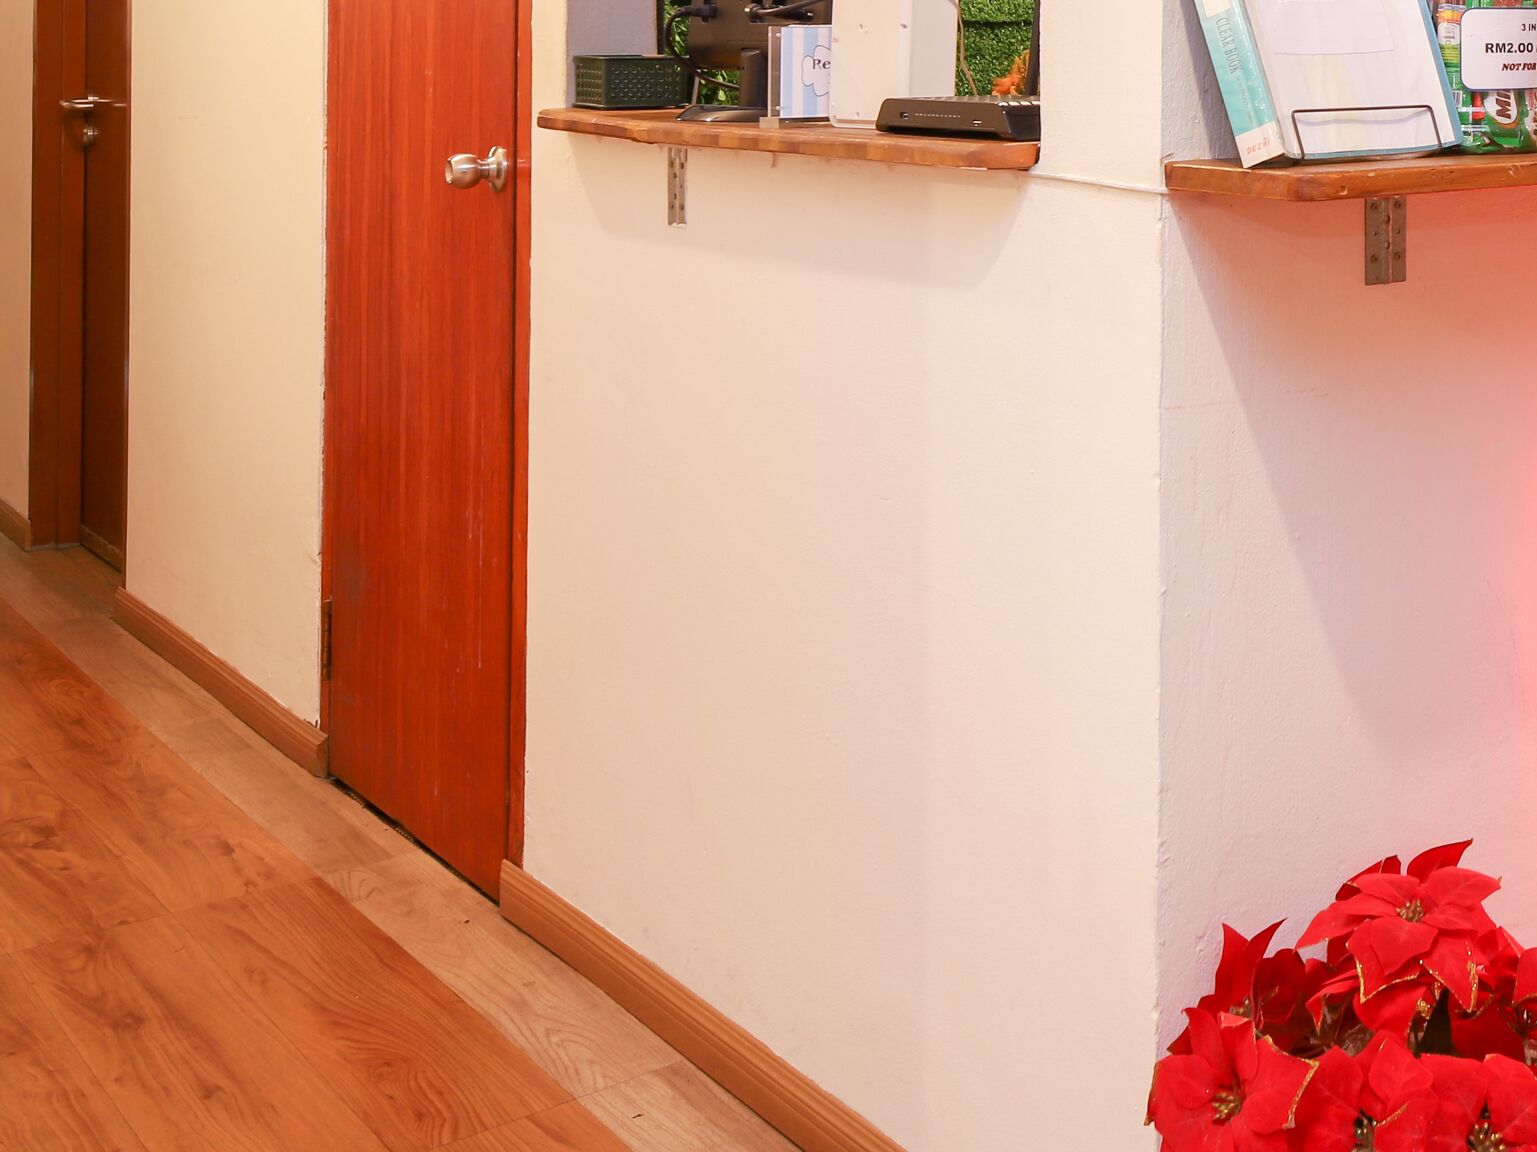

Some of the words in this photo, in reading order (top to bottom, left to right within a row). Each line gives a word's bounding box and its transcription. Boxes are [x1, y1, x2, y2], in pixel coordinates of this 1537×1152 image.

[1215, 17, 1235, 48] CLEAR
[1521, 23, 1527, 32] 3
[1528, 23, 1537, 32] IN
[1484, 42, 1534, 54] RM2.00
[1224, 45, 1243, 75] BOOK
[1501, 63, 1521, 71] NOT
[1522, 62, 1536, 71] FOR
